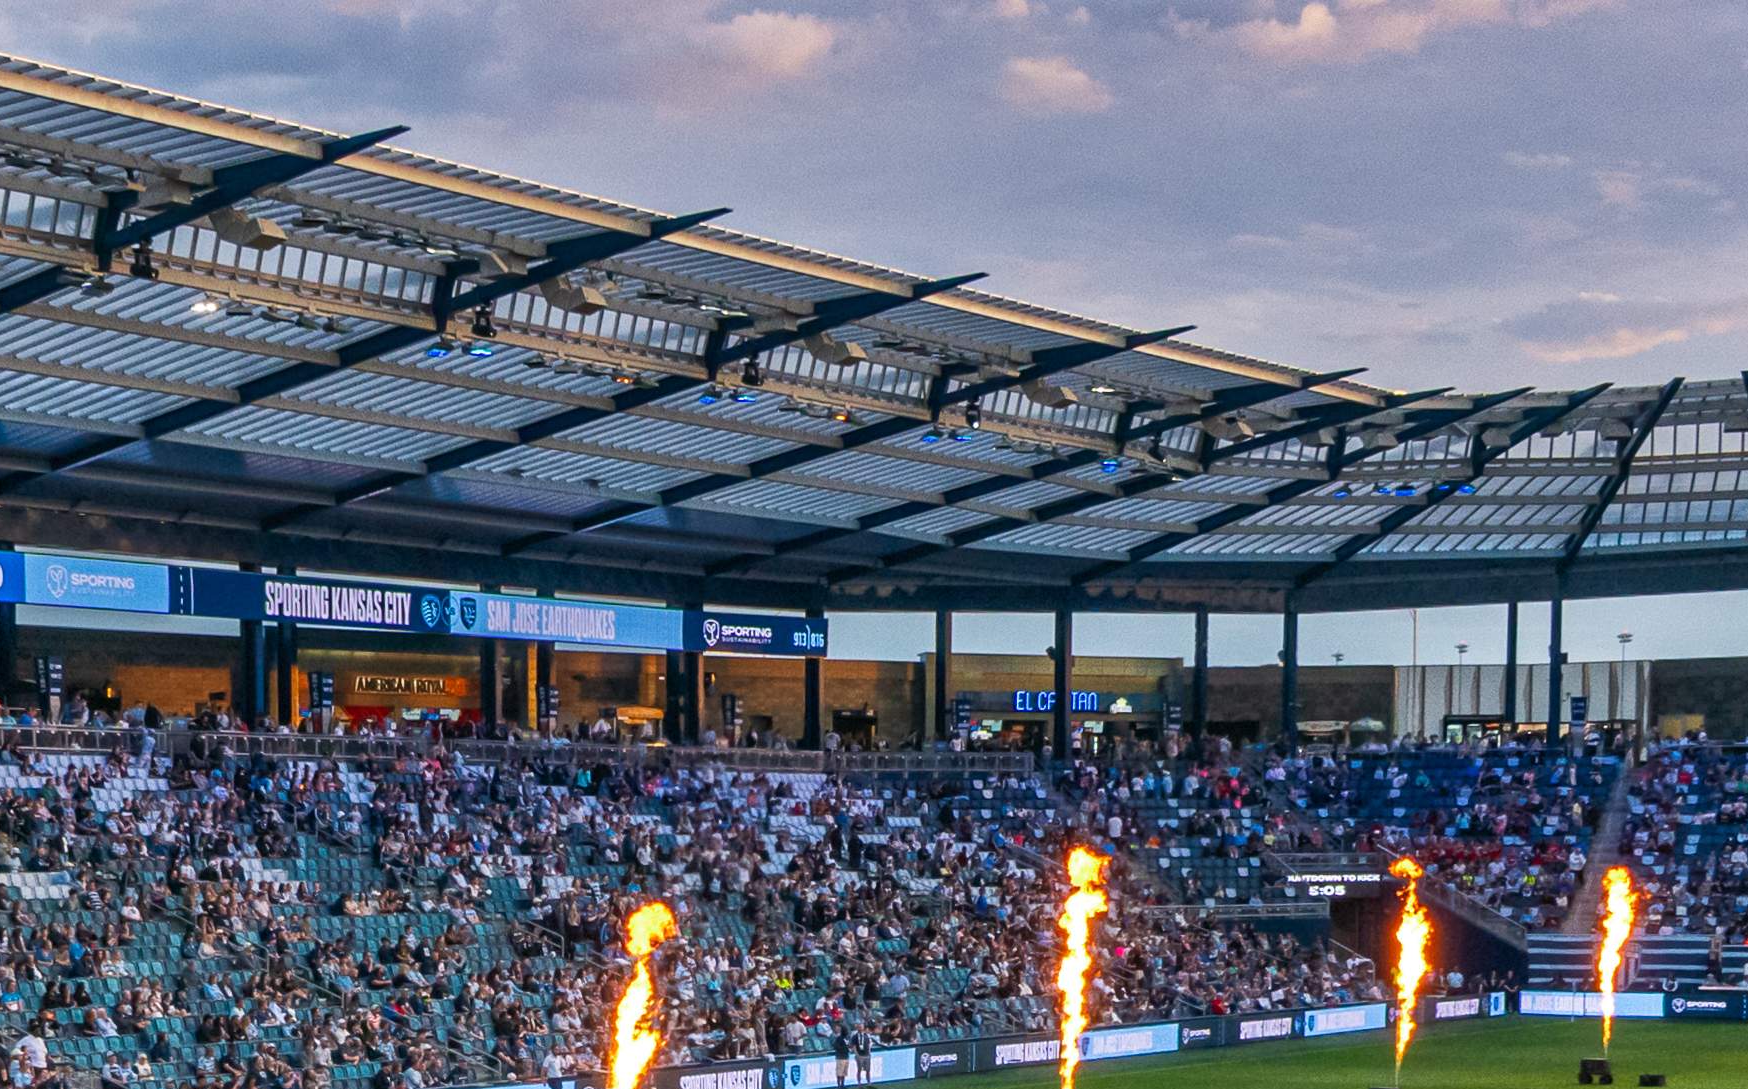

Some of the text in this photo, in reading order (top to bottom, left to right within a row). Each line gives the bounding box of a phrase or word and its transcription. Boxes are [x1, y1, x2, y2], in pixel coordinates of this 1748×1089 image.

[71, 573, 135, 590] SPORTING
[265, 581, 411, 625] SPORTING KANSAS CITY
[487, 600, 615, 641] SAN JOSE EARTHQUAKES
[721, 625, 772, 638] SPORTING
[1016, 690, 1034, 711] EL
